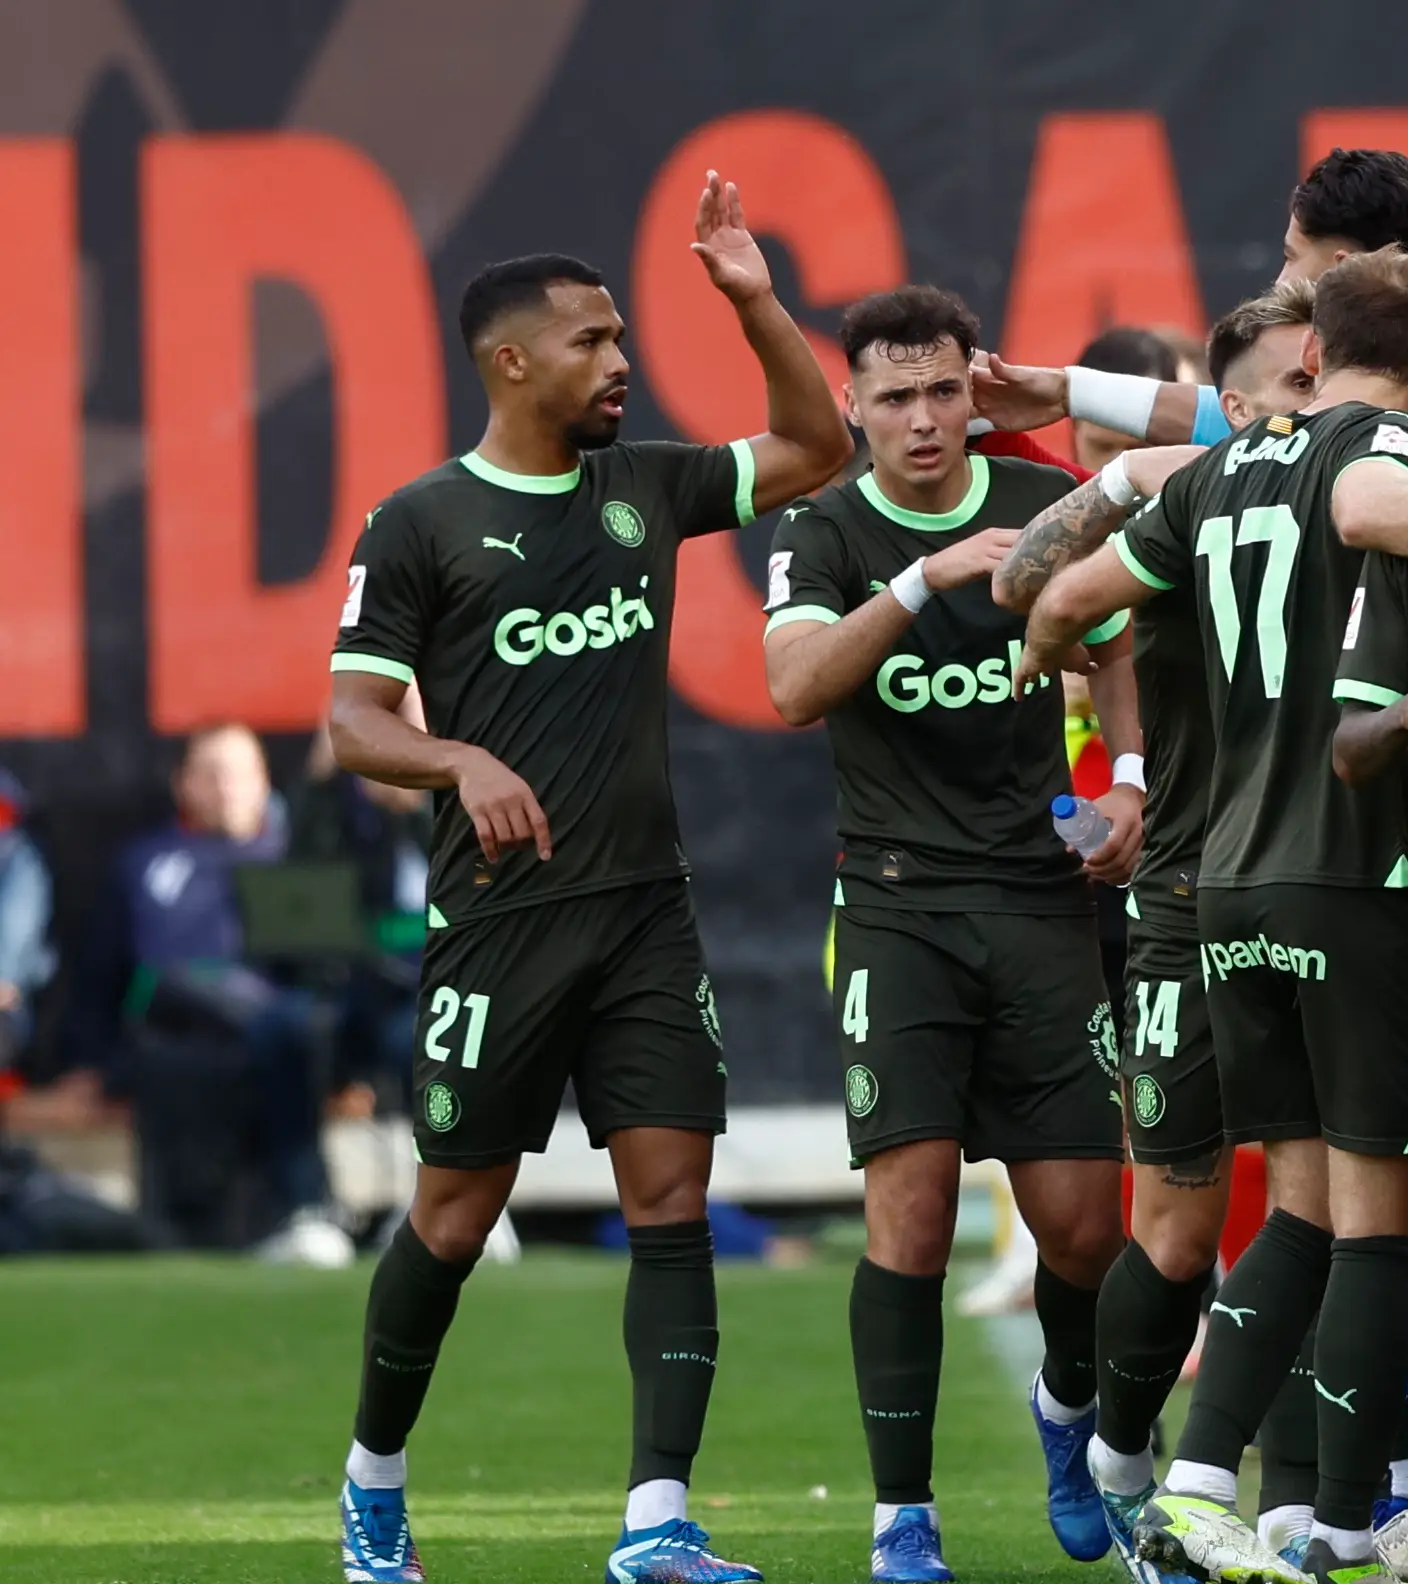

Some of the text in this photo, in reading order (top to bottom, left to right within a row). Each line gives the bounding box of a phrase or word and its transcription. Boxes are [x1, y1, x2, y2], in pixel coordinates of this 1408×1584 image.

[494, 575, 655, 666] Gosbi
[1195, 504, 1301, 699] 17
[1207, 933, 1326, 981] parlem
[425, 986, 490, 1069] 21
[842, 968, 869, 1043] 4
[1135, 980, 1182, 1058] 14
[661, 1352, 717, 1368] GIRONA
